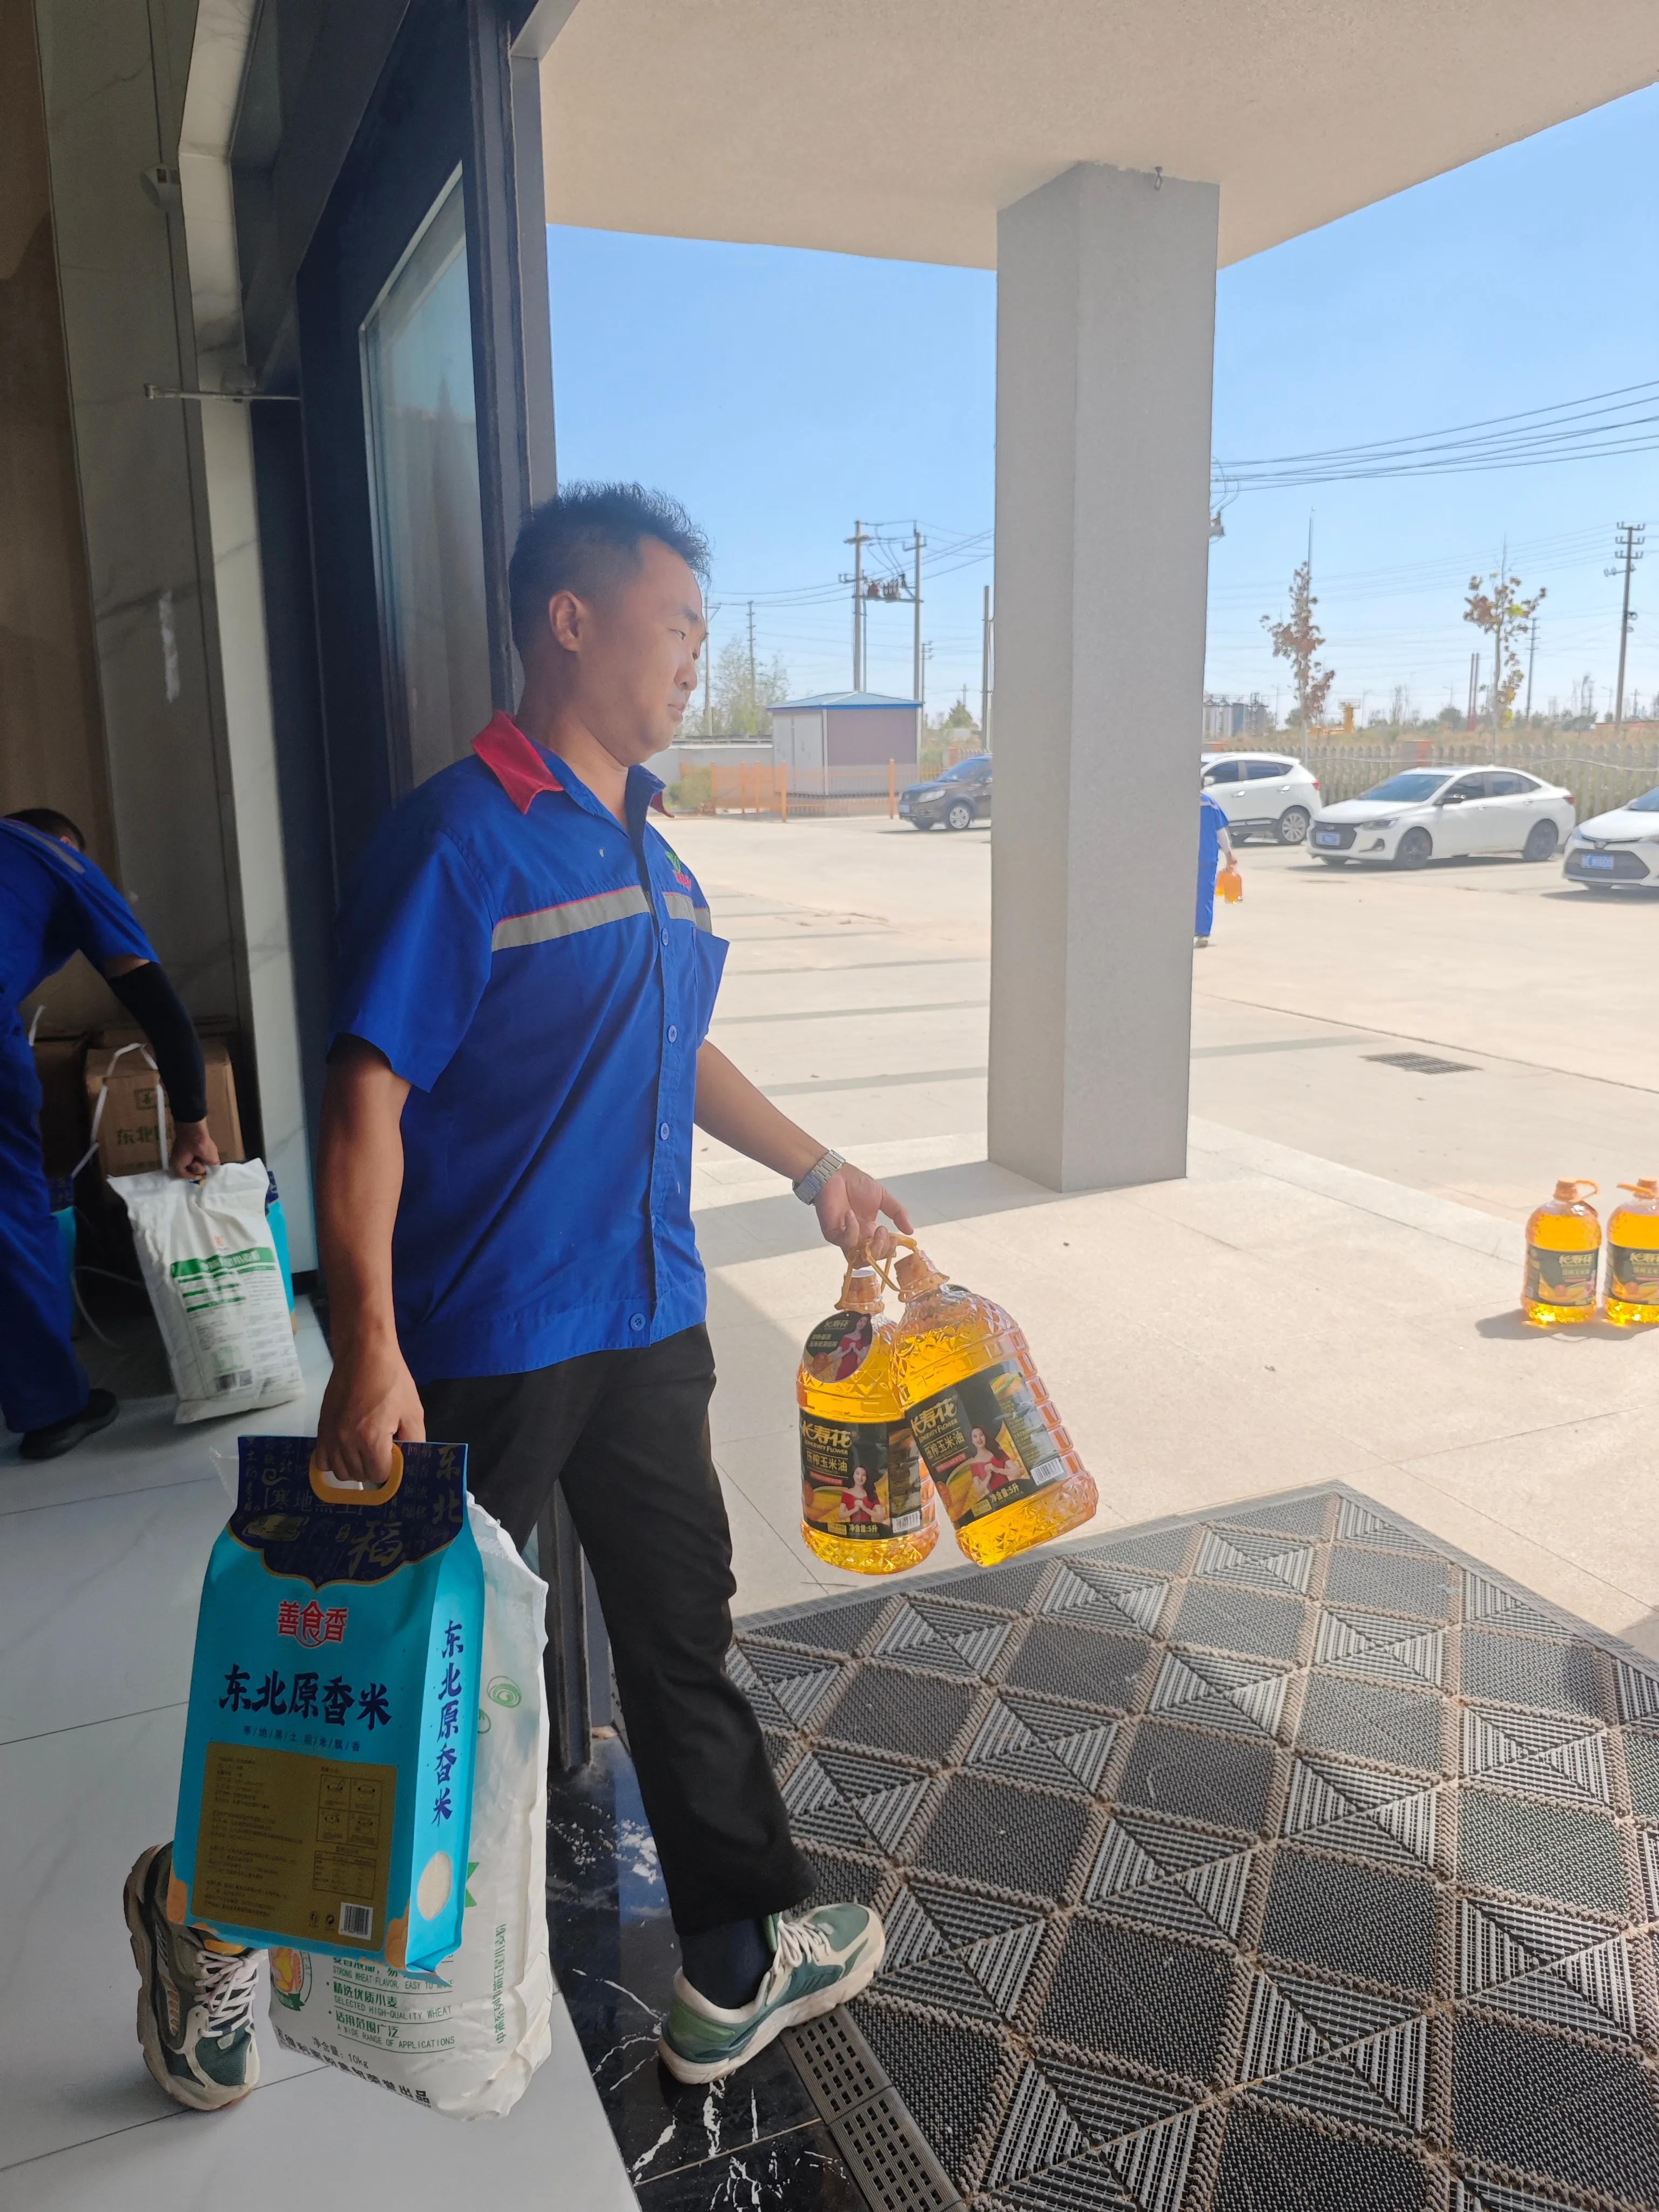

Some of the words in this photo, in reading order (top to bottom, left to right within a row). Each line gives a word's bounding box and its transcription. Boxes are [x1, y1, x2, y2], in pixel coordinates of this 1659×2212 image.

[911, 1398, 957, 1437] 长寿花
[937, 1418, 959, 1433] FLOWER
[802, 1420, 852, 1448] 长寿花
[826, 1446, 848, 1455] FLOWER
[277, 1599, 348, 1648] 善食香
[219, 1663, 393, 1731] 东北原香米
[432, 1620, 464, 1827] 东北原香米
[333, 1965, 352, 1978] STRONG
[355, 1971, 373, 1983] WHEAT
[405, 1981, 421, 1990] EASY
[333, 1981, 397, 2008] 精选优质小麦
[334, 1995, 366, 2012] SELECTED
[369, 2006, 422, 2020] HIGH-QUALITY
[427, 2005, 451, 2019] WHEAT
[335, 2009, 399, 2038] 适用范围广泛
[337, 2023, 341, 2031] A
[343, 2026, 359, 2038] WIDE
[362, 2031, 382, 2045] RANGE
[386, 2038, 394, 2047] OF
[399, 2036, 455, 2049] APPLICATIONS
[347, 2053, 369, 2069] 10kg
